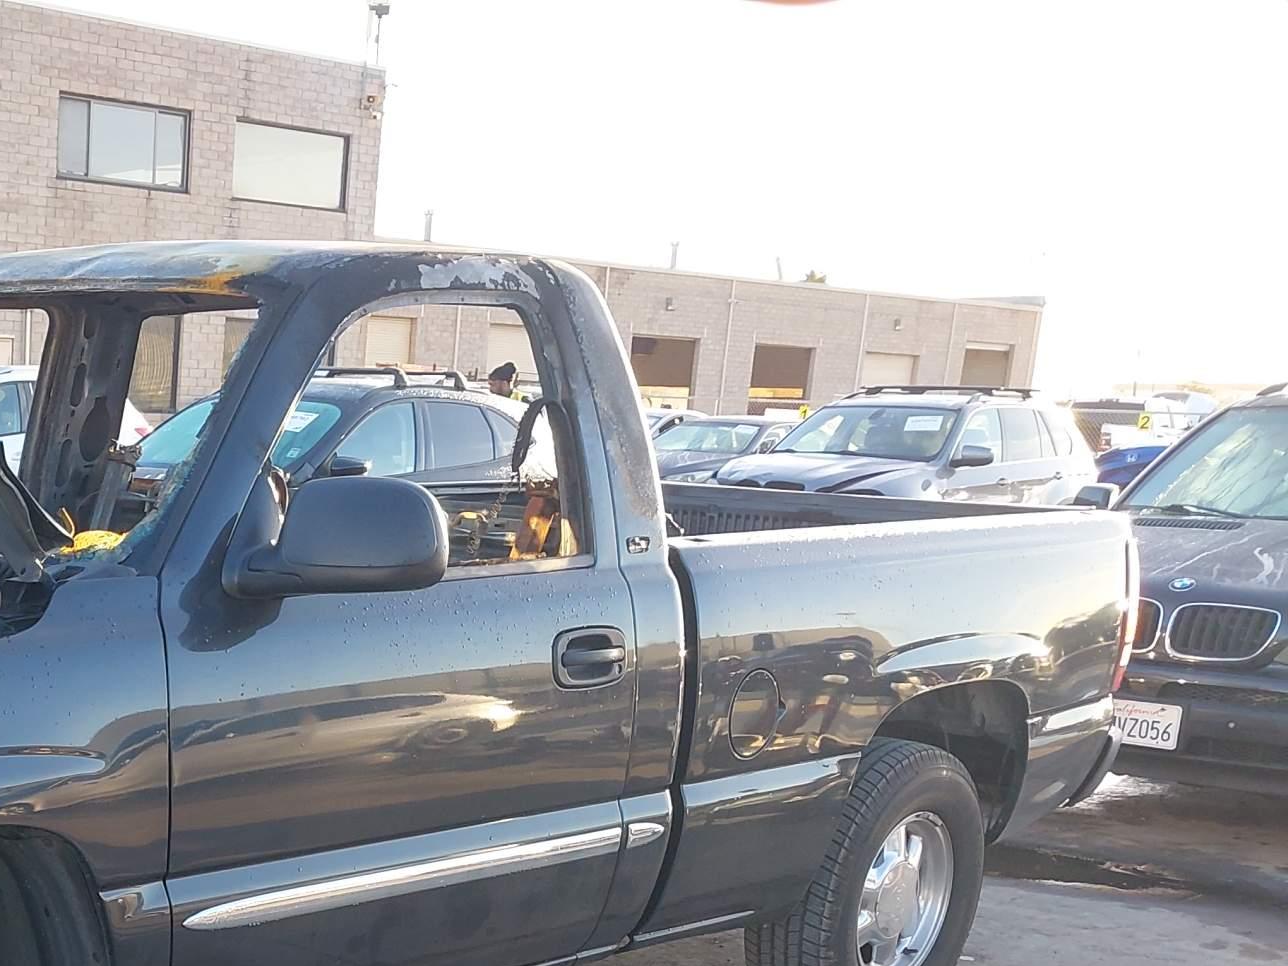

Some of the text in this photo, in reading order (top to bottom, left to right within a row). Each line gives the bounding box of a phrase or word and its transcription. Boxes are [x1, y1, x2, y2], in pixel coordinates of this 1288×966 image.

[1140, 415, 1150, 430] 2
[1113, 703, 1161, 716] alifornia
[1112, 716, 1173, 742] VZ056
